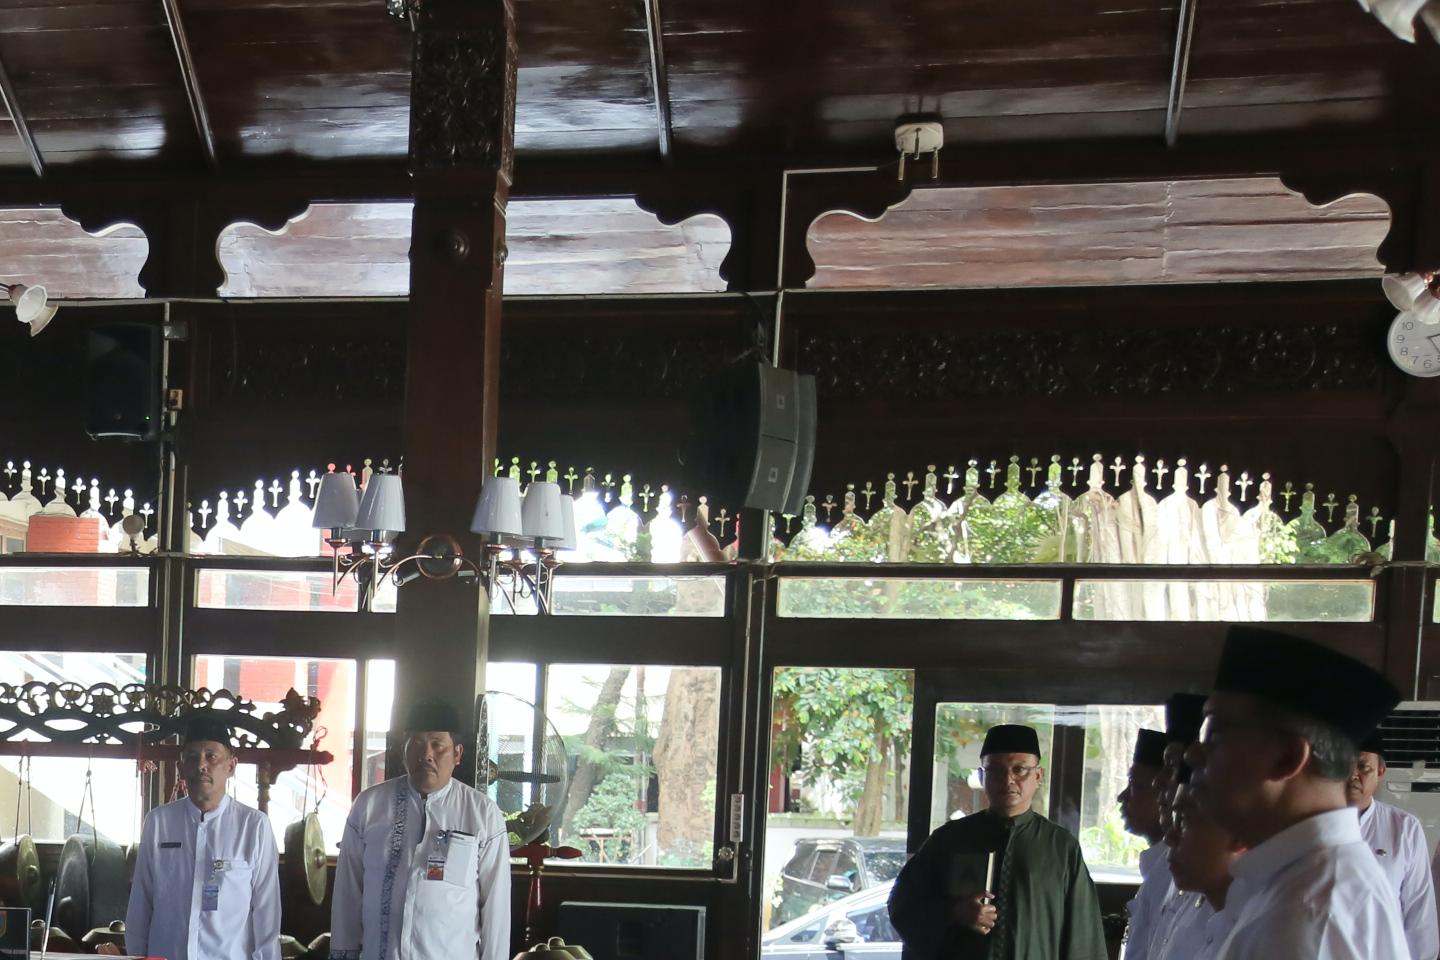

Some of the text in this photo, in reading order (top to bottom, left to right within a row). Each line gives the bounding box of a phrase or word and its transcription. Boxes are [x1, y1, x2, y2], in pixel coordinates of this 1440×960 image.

[1401, 321, 1414, 331] 10
[1396, 334, 1405, 344] 9
[1400, 347, 1408, 356] 8
